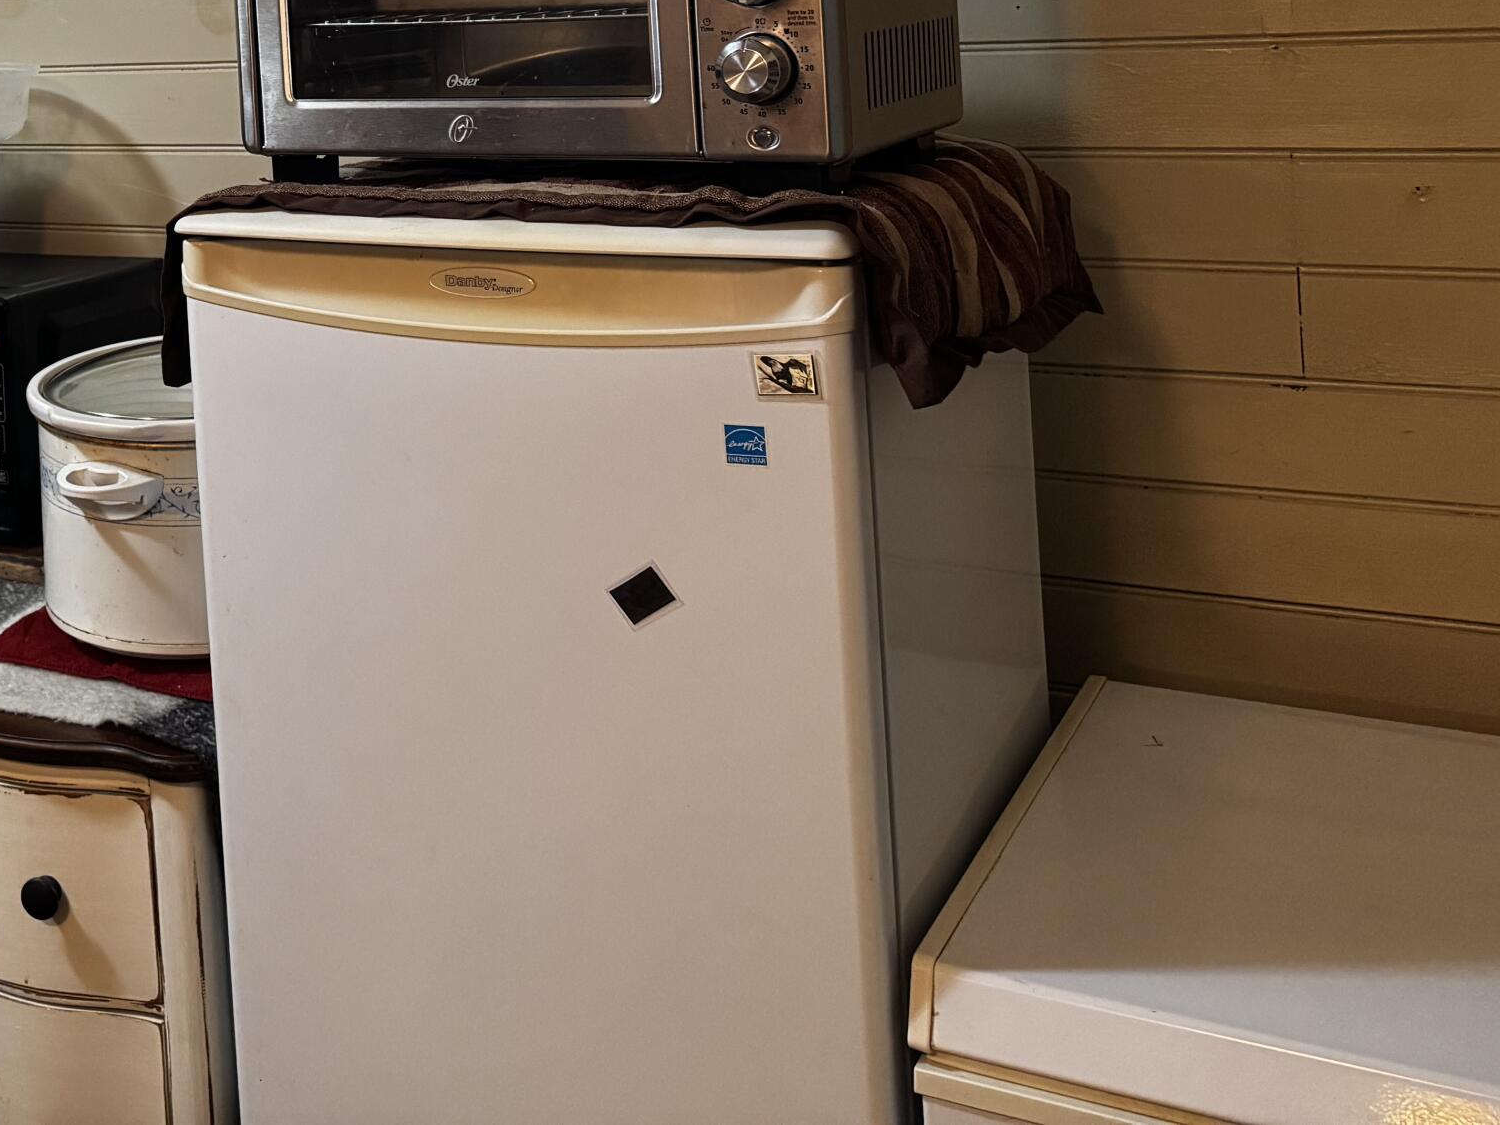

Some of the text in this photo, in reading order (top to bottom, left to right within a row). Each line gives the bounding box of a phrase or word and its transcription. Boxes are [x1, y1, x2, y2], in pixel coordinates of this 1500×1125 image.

[773, 20, 779, 28] 5
[805, 64, 814, 72] 20
[446, 73, 480, 88] Oster
[444, 274, 524, 294] Danby Designer
[751, 456, 766, 464] STAR
